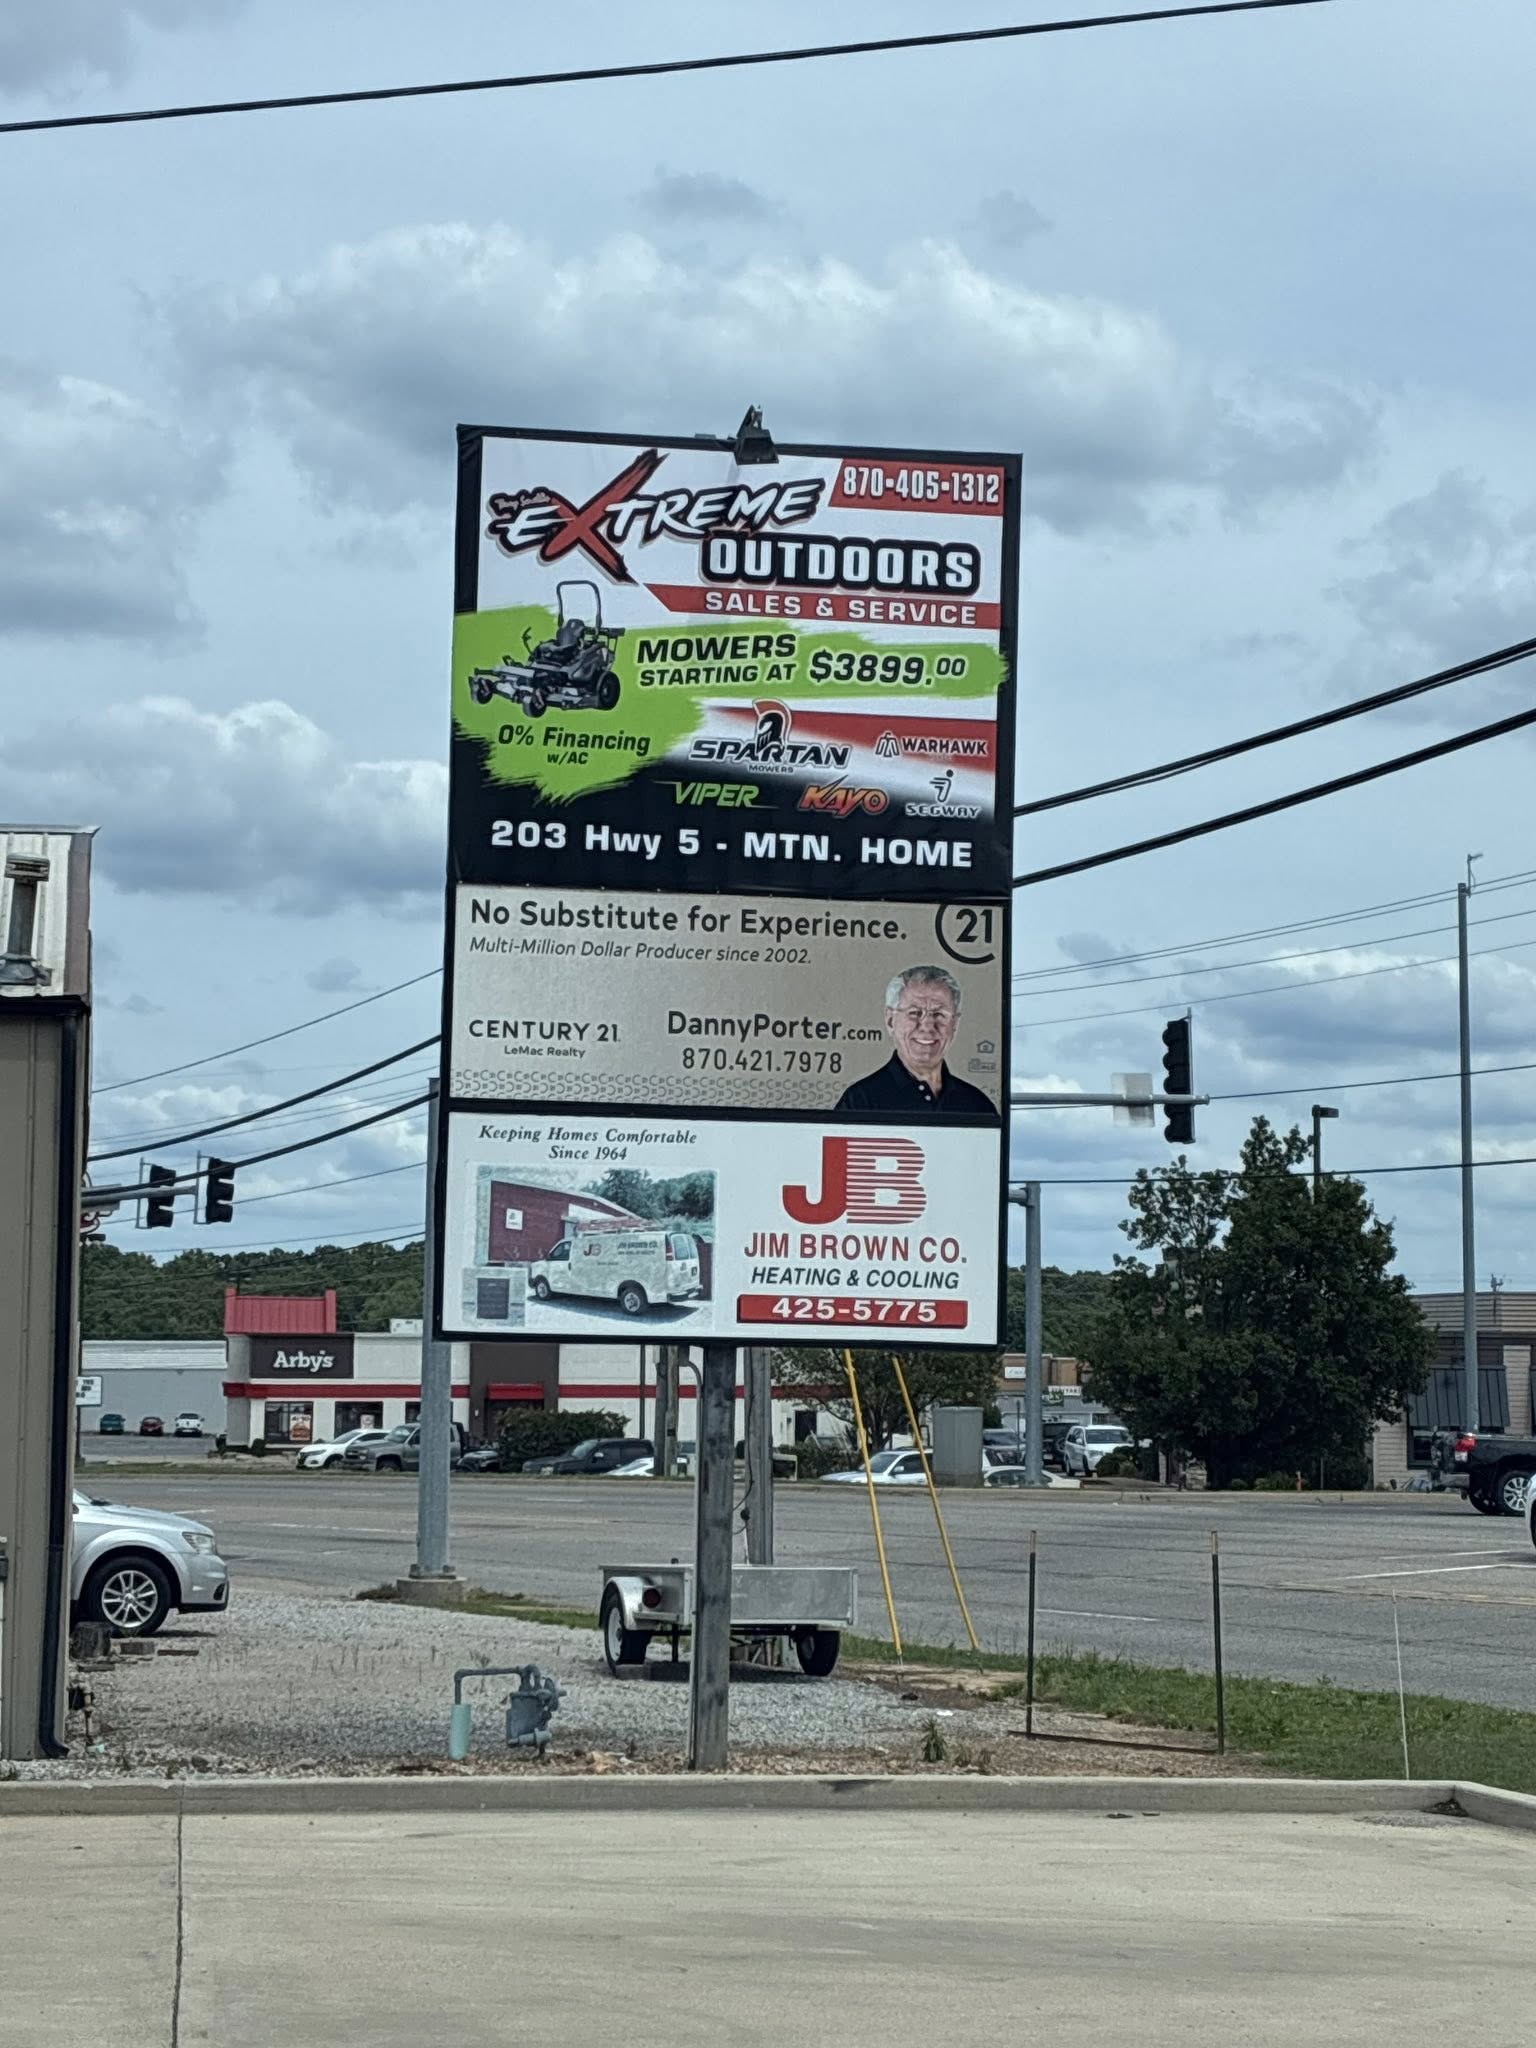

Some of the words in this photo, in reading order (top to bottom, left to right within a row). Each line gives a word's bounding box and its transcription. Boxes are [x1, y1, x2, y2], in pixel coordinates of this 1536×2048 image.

[490, 448, 825, 585] EXTREME
[708, 538, 973, 588] OUTDOORS
[705, 591, 800, 615] SALES
[815, 598, 833, 617] &
[849, 599, 976, 625] SERVICE
[637, 634, 796, 663] MOWERS
[640, 664, 758, 687] STARTING
[765, 664, 796, 681] AT
[809, 649, 966, 686] $3899.00
[498, 724, 534, 746] 0%
[542, 726, 651, 757] Financing
[690, 739, 850, 767] SPARTAN
[902, 737, 987, 755] WARHAWK
[547, 752, 588, 765] w/AC
[749, 764, 794, 773] MOWERS
[673, 781, 760, 808] VIPER
[799, 775, 888, 818] KAYO
[905, 804, 980, 818] SEGWAY
[491, 820, 567, 849] 203
[585, 824, 662, 860] Hwy
[678, 829, 700, 855] 5
[743, 832, 842, 862] MTN.
[861, 837, 972, 867] HOME
[471, 899, 511, 925] No
[519, 900, 679, 931] Substitute
[688, 905, 731, 933] for
[741, 909, 908, 943] Experience.
[469, 937, 576, 956] Multi-Million
[581, 941, 631, 957] Dollar
[635, 943, 713, 961] Producer
[716, 945, 760, 963] since
[764, 948, 812, 965] 2002.
[468, 1019, 590, 1041] CENTURY
[597, 1024, 618, 1043] 21
[668, 1010, 883, 1044] DannyPorter.com
[504, 1045, 544, 1057] LeMac
[547, 1047, 586, 1059] Realty
[682, 1047, 843, 1075] 870.421.7978
[478, 1125, 542, 1143] Keeping
[547, 1127, 599, 1142] Homes
[605, 1128, 697, 1145] Comfortable
[549, 1146, 589, 1160] Since
[594, 1147, 627, 1161] 1964
[782, 1135, 927, 1225] JB
[744, 1232, 789, 1258] JIM
[799, 1233, 910, 1262] BROWN
[919, 1236, 967, 1264] CO.
[751, 1266, 841, 1287] HEATING
[846, 1269, 860, 1287] &
[866, 1269, 960, 1289] COOLING
[772, 1297, 937, 1323] 425-5775
[273, 1350, 335, 1372] Arby's
